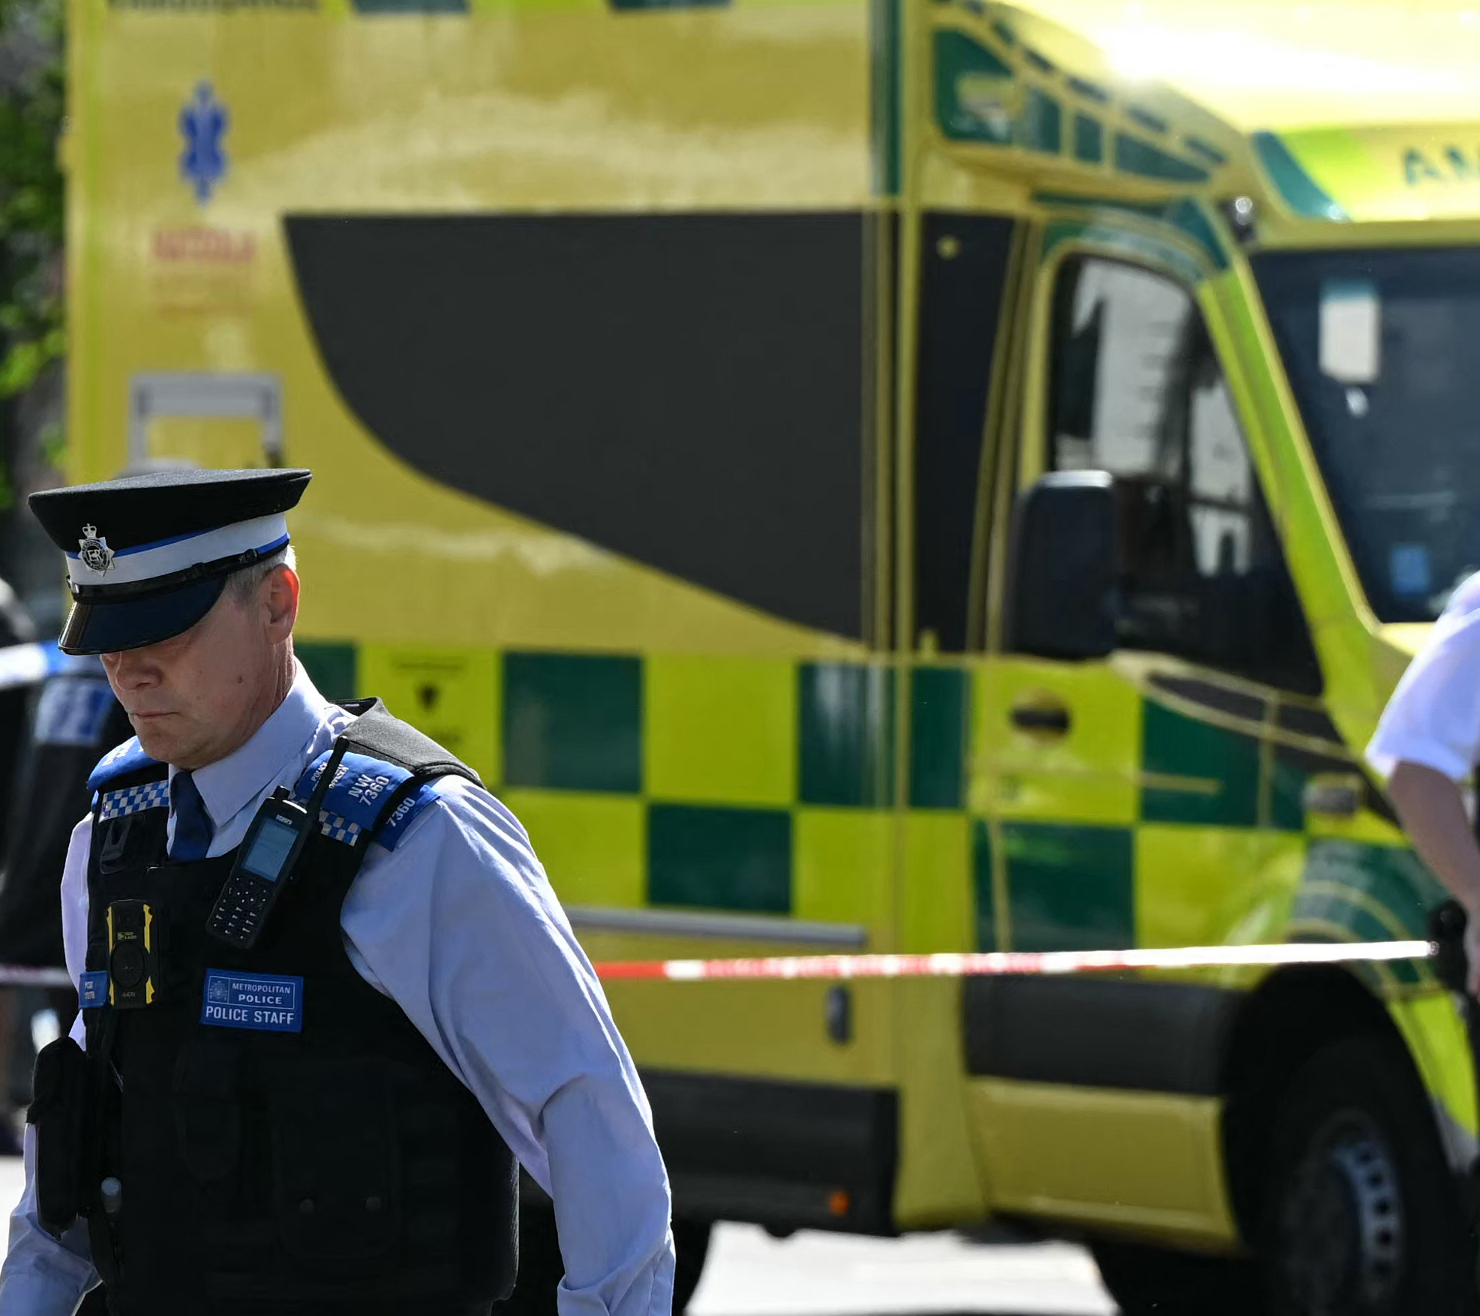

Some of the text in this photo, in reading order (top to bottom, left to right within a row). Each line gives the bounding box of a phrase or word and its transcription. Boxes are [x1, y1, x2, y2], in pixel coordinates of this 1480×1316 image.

[348, 774, 375, 798] NW
[359, 776, 390, 806] 7360
[386, 797, 416, 827] 7360
[232, 983, 291, 994] METROPOLITAN
[239, 994, 283, 1004] POLICE
[205, 1006, 295, 1024] POLICE STAFF
